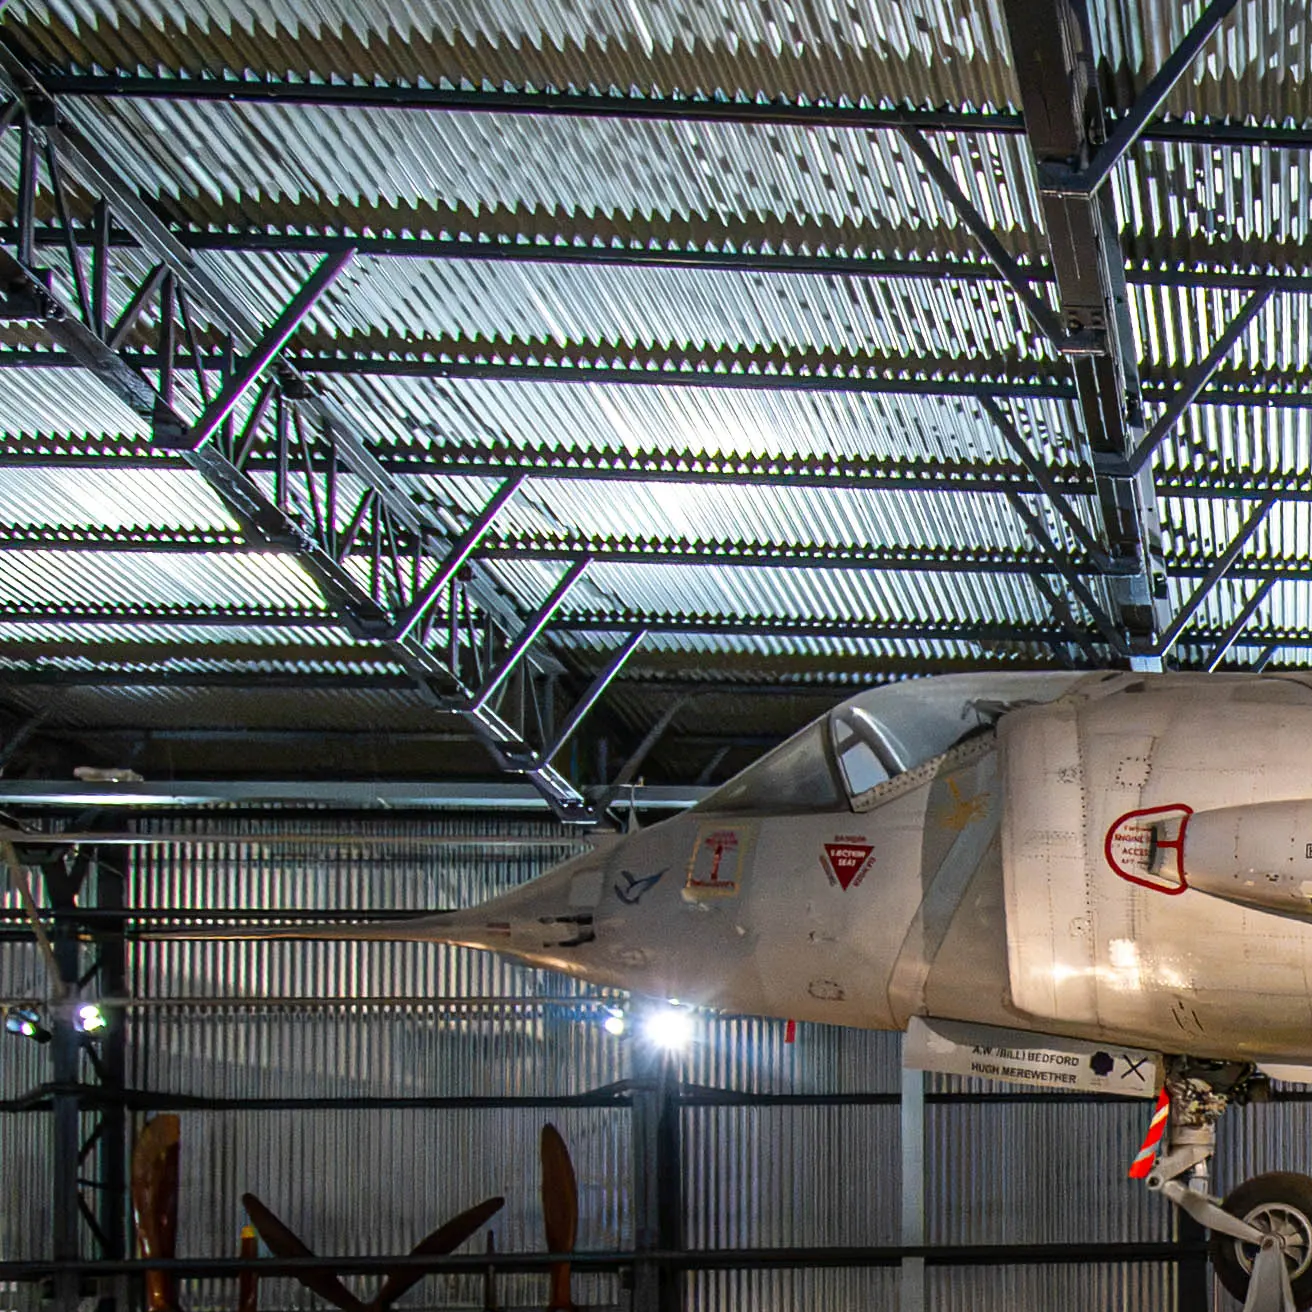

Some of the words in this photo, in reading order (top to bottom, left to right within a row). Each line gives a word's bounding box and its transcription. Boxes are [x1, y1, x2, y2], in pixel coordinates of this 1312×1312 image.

[1027, 1051, 1080, 1067] BEDFORD
[971, 1062, 1000, 1075] HUGH
[1001, 1066, 1077, 1084] MEREWETHER
